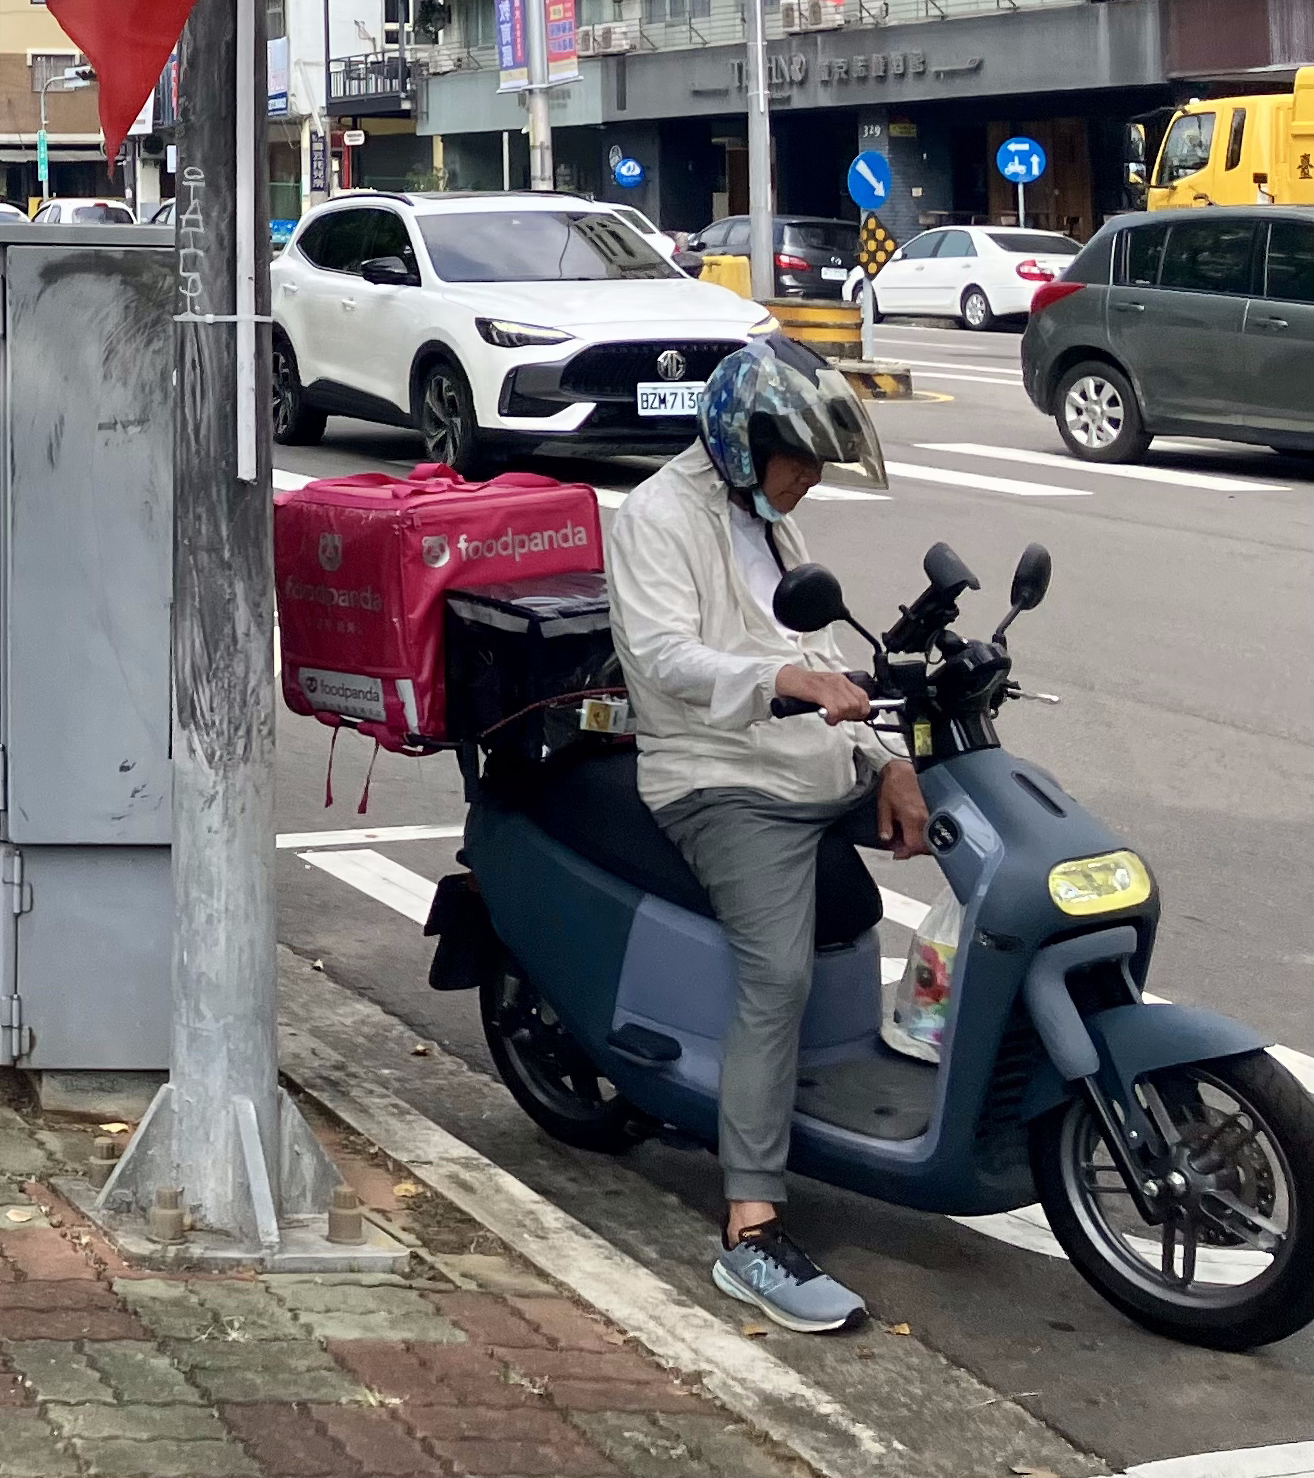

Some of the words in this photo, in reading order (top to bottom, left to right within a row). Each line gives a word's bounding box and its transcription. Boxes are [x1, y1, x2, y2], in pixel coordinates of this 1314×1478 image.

[657, 350, 686, 381] MG
[456, 521, 588, 562] foodpanda
[284, 575, 384, 612] foodpanda
[320, 678, 381, 703] foodpanda
